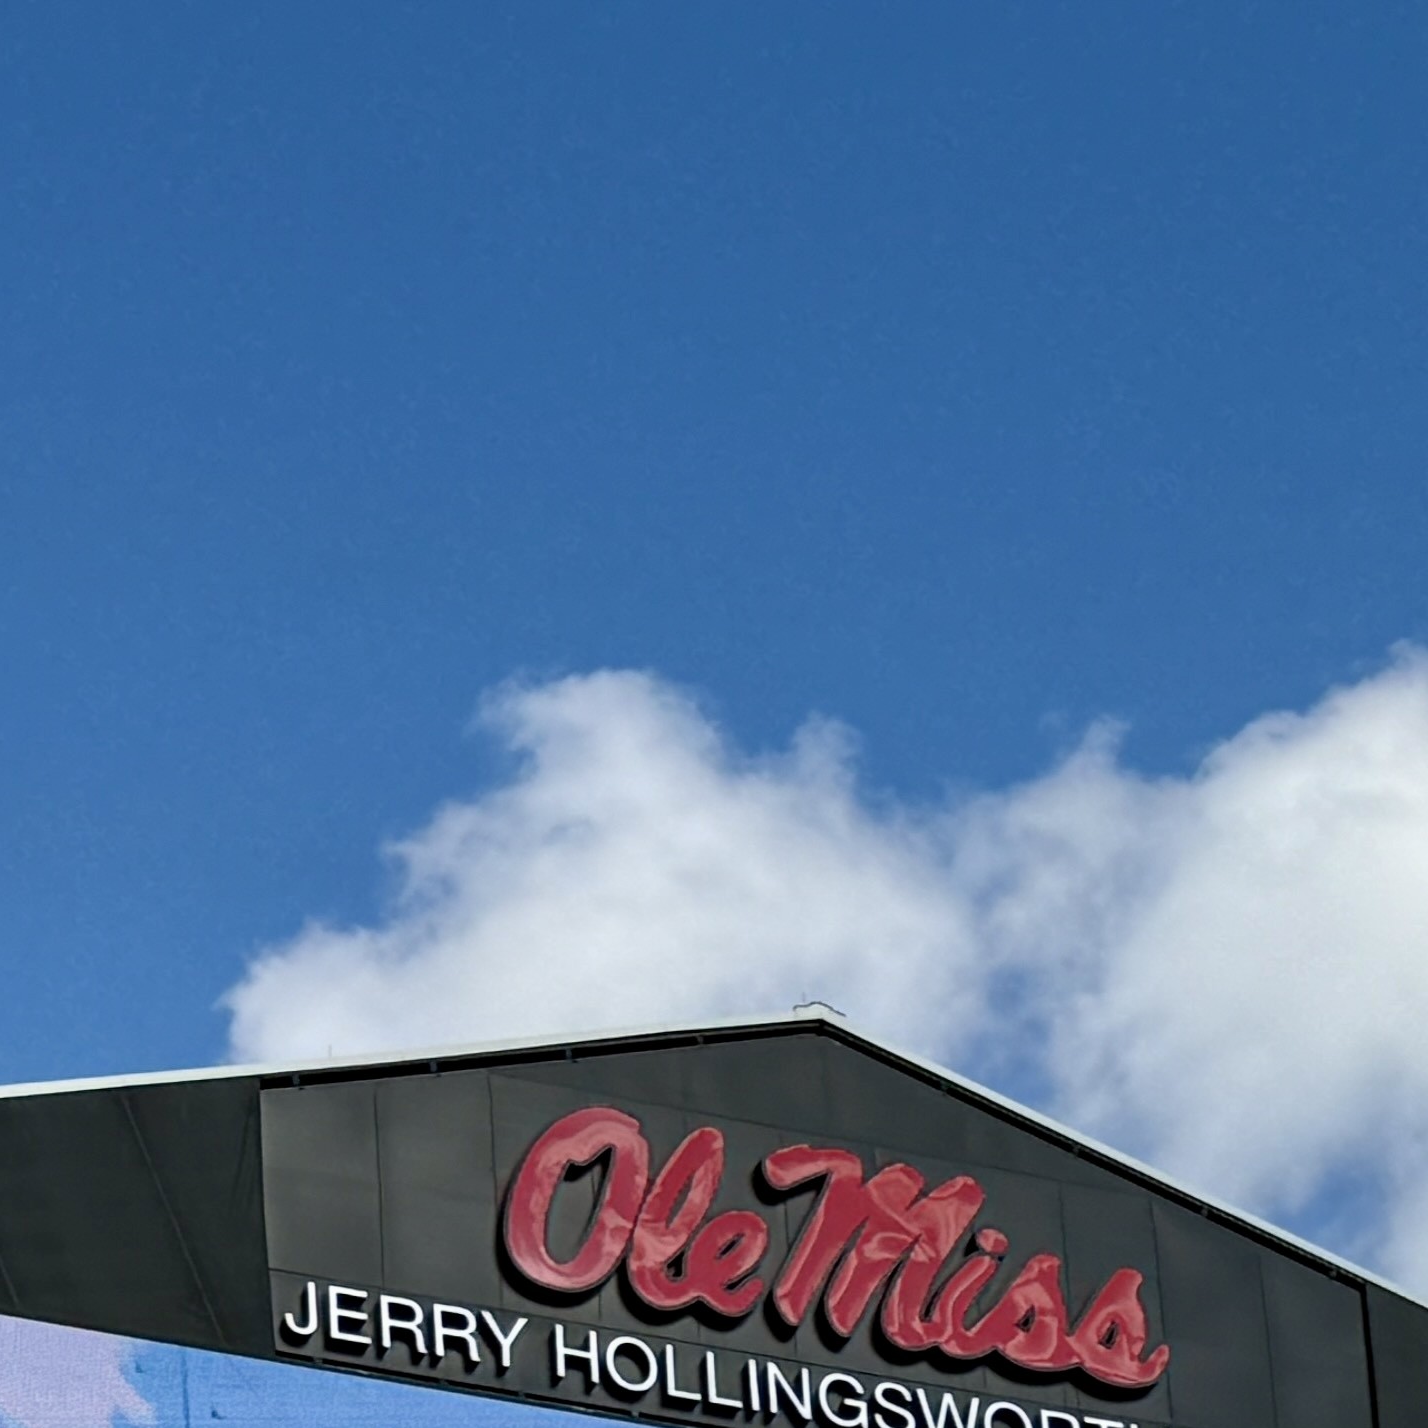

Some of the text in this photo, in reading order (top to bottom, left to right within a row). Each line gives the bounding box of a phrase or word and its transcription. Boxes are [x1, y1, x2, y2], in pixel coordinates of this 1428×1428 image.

[284, 1280, 529, 1370] JERRY
[502, 1103, 1170, 1388] Ole Miss
